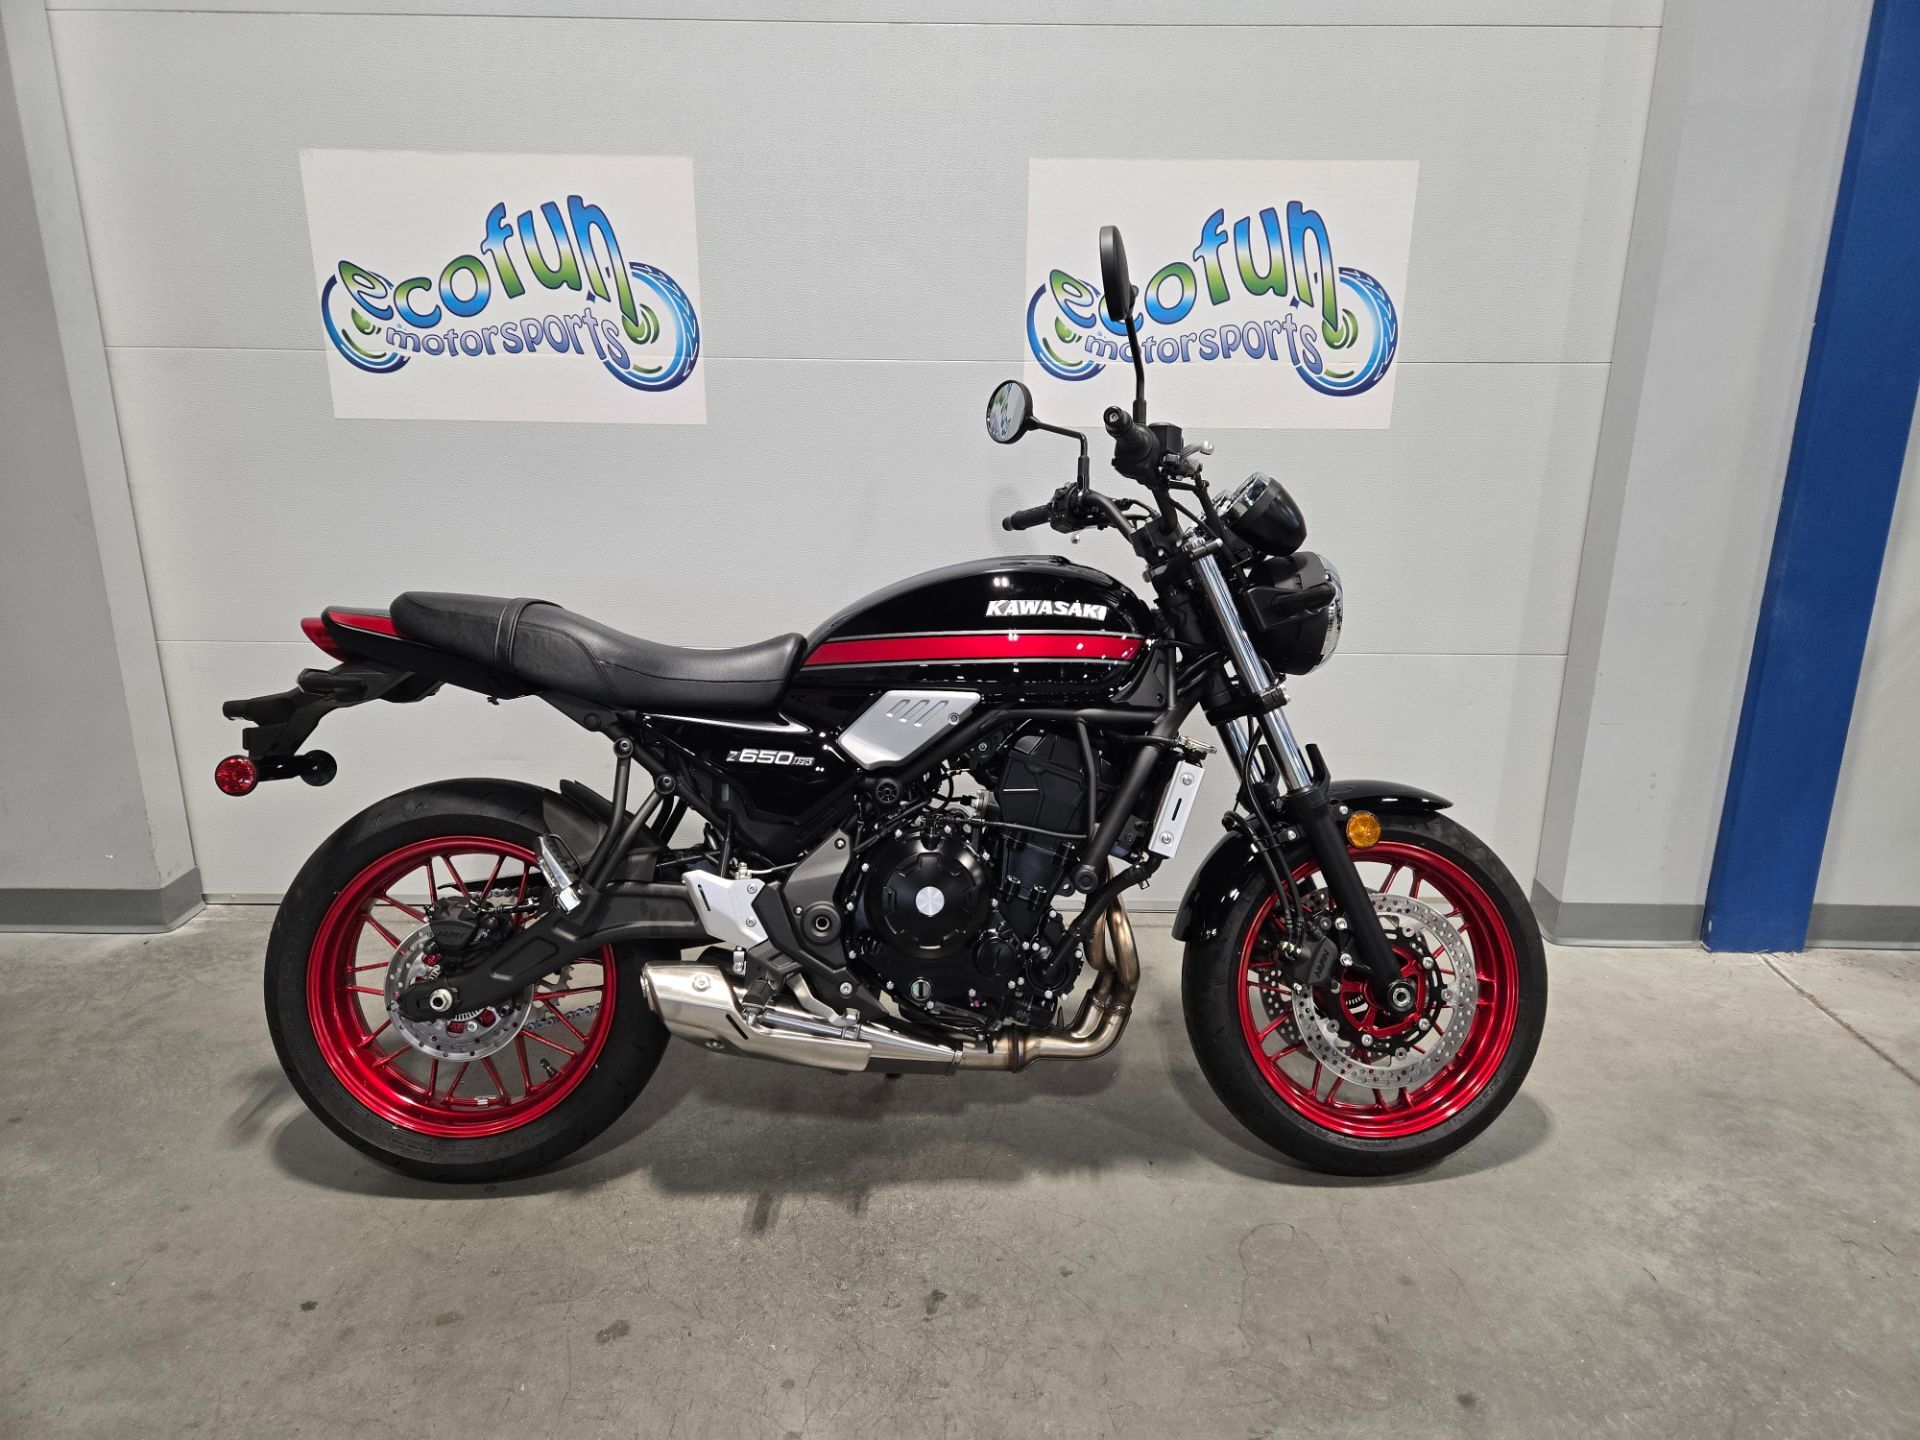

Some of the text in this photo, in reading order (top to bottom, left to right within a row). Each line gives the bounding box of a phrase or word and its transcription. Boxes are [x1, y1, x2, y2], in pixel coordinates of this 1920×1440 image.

[338, 195, 639, 328] ecofun
[386, 307, 631, 370] motorsports
[1084, 312, 1324, 375] motorsports
[985, 600, 1107, 621] KAWASAKI
